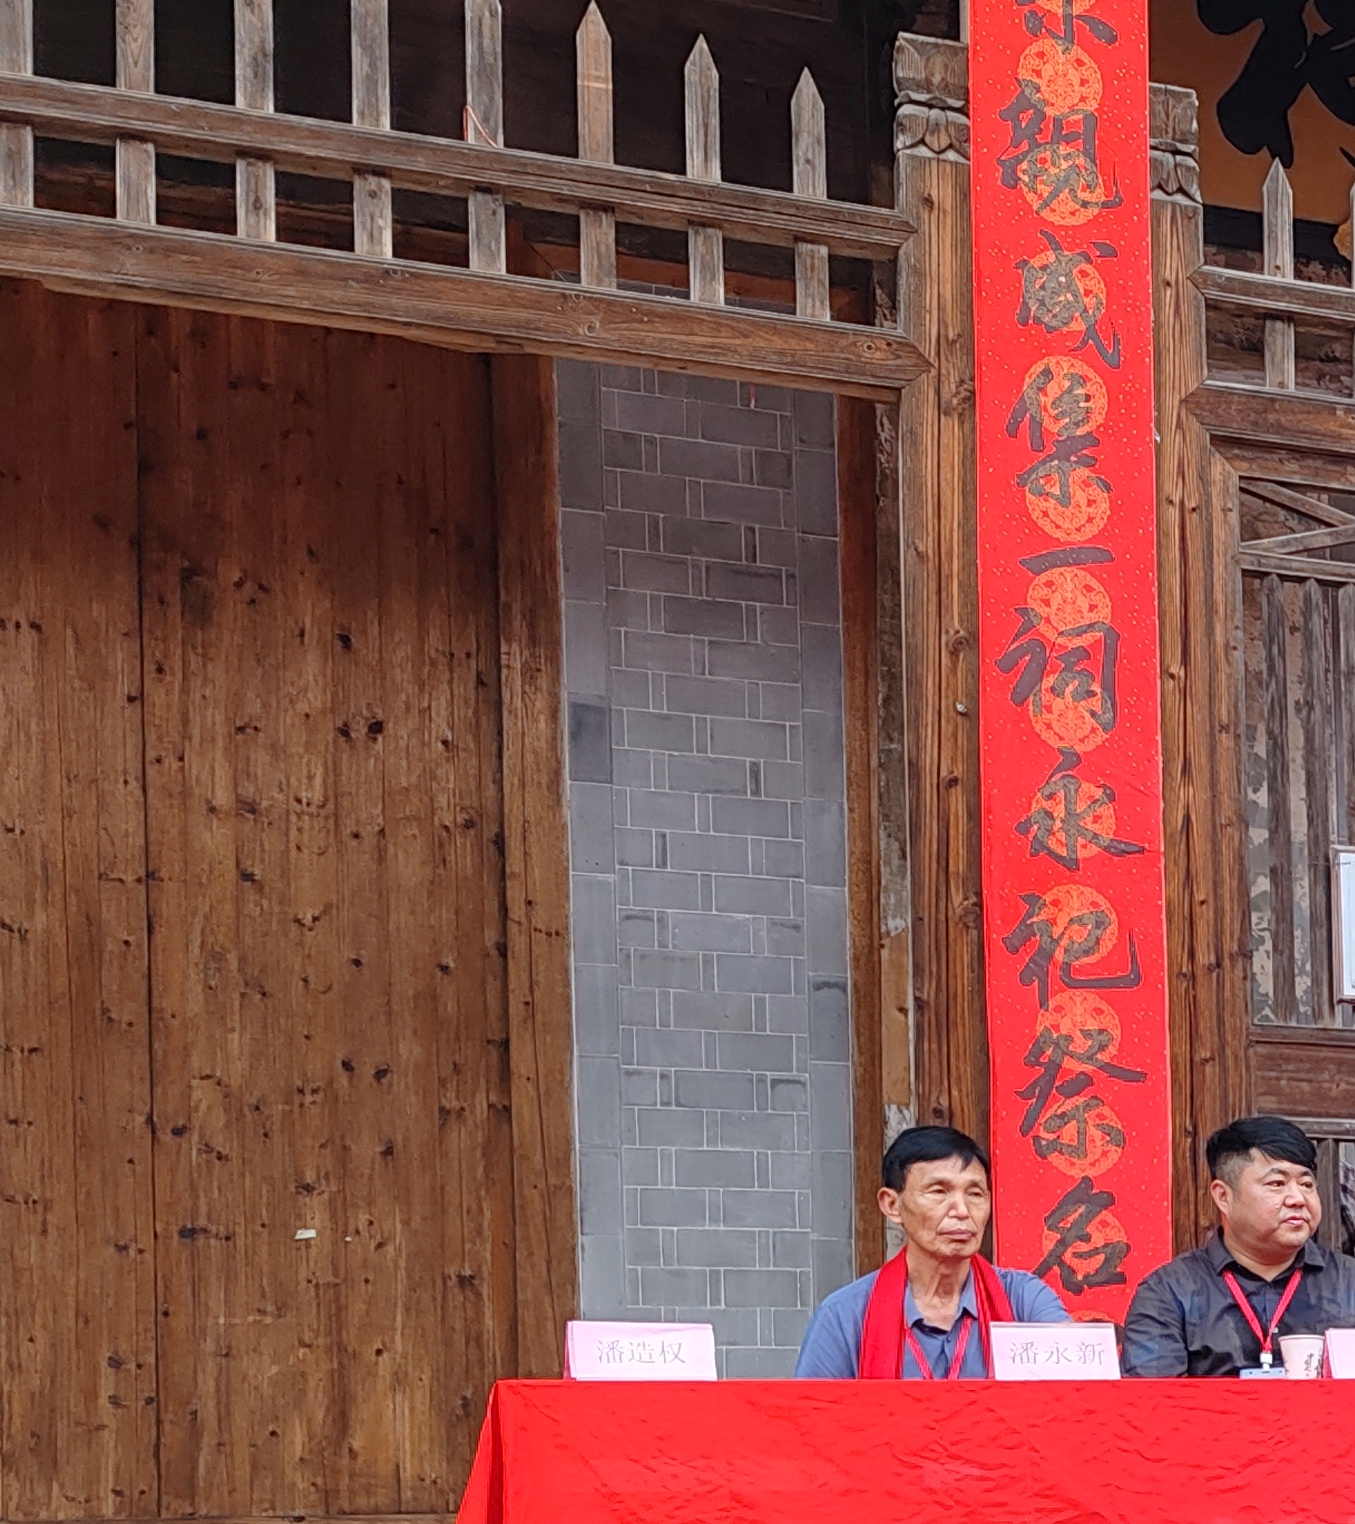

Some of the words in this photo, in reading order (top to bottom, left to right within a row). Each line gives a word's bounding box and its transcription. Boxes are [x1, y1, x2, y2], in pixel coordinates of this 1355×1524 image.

[597, 1340, 686, 1364] 潘造权
[1009, 1341, 1105, 1365] 潘永新
